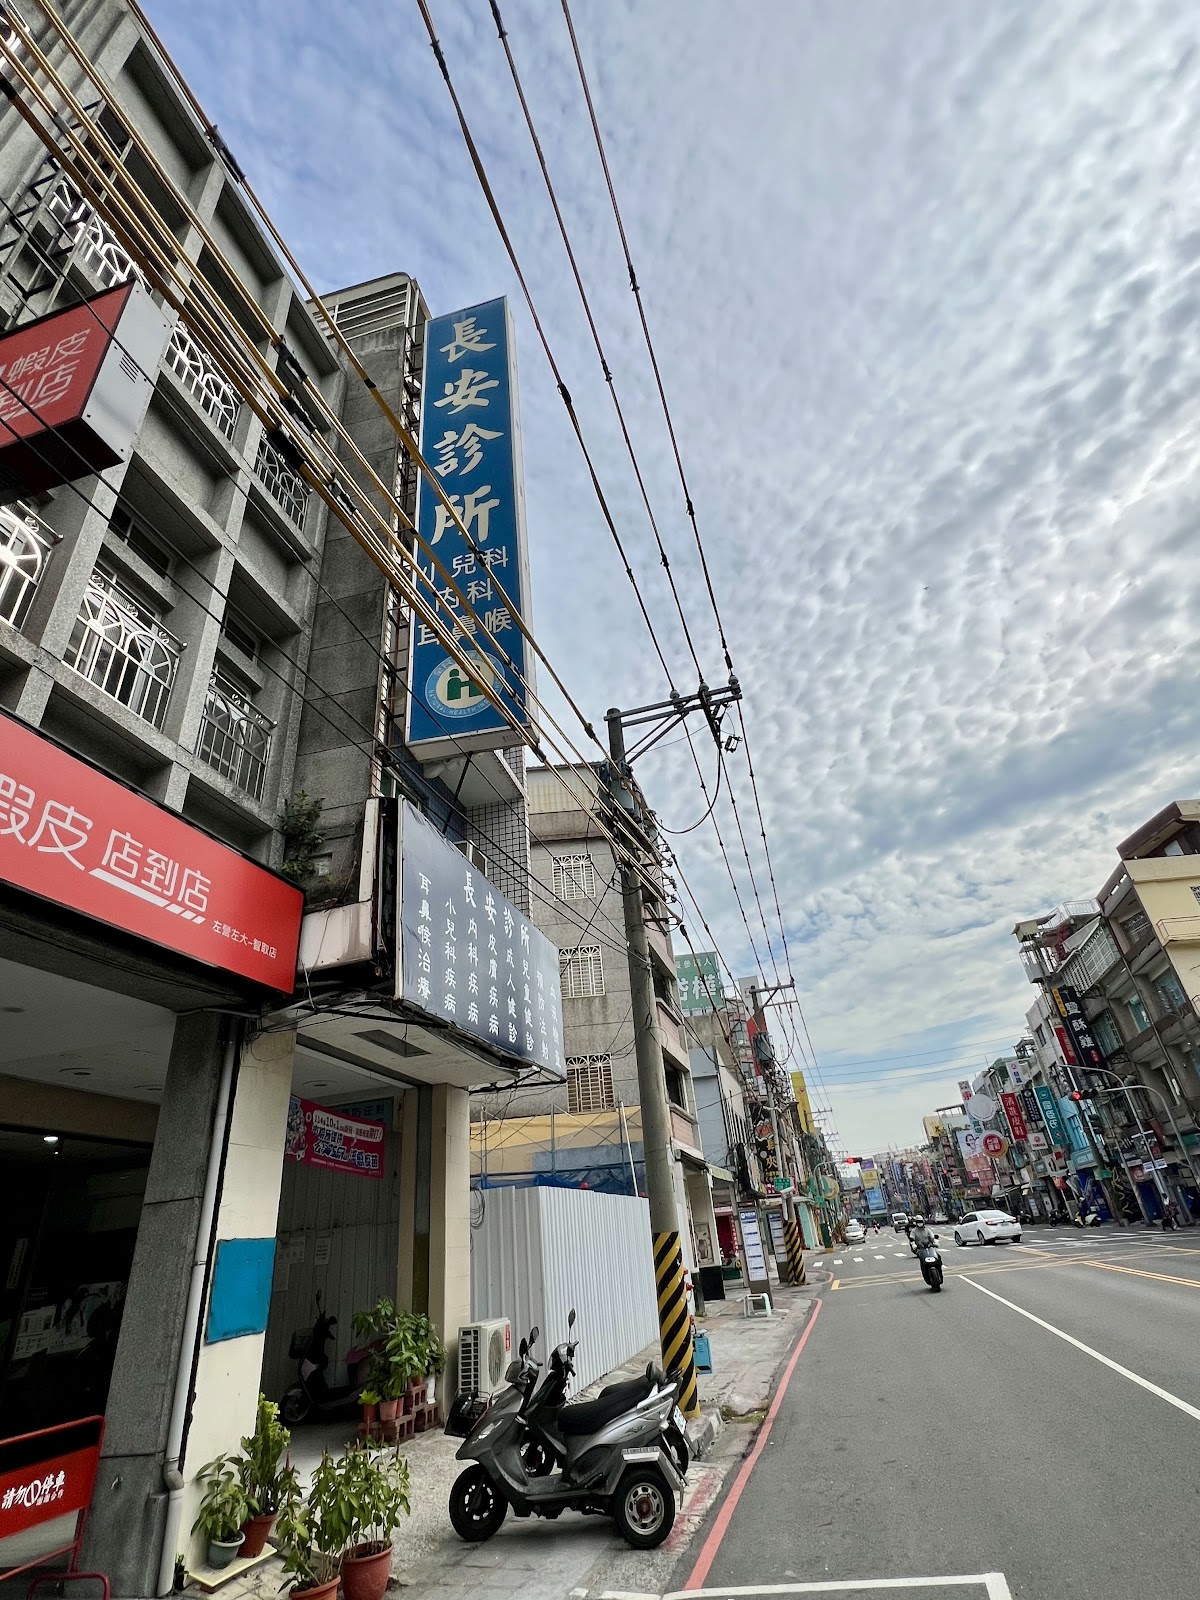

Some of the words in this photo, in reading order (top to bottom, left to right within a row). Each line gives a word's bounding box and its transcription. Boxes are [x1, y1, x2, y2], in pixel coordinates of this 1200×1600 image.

[6, 328, 91, 384] 蝦皮
[431, 316, 504, 545] 長安診所
[436, 577, 493, 612] 內科
[101, 829, 212, 912] 店到店
[463, 870, 531, 954] 長安診所
[212, 920, 278, 959] 左營左大-智取店
[417, 872, 432, 1000] 耳鼻喉治療
[444, 897, 457, 1014] 小兒科疾病
[466, 918, 479, 1025] 內科疾病
[488, 933, 500, 1036] 皮膚疾病
